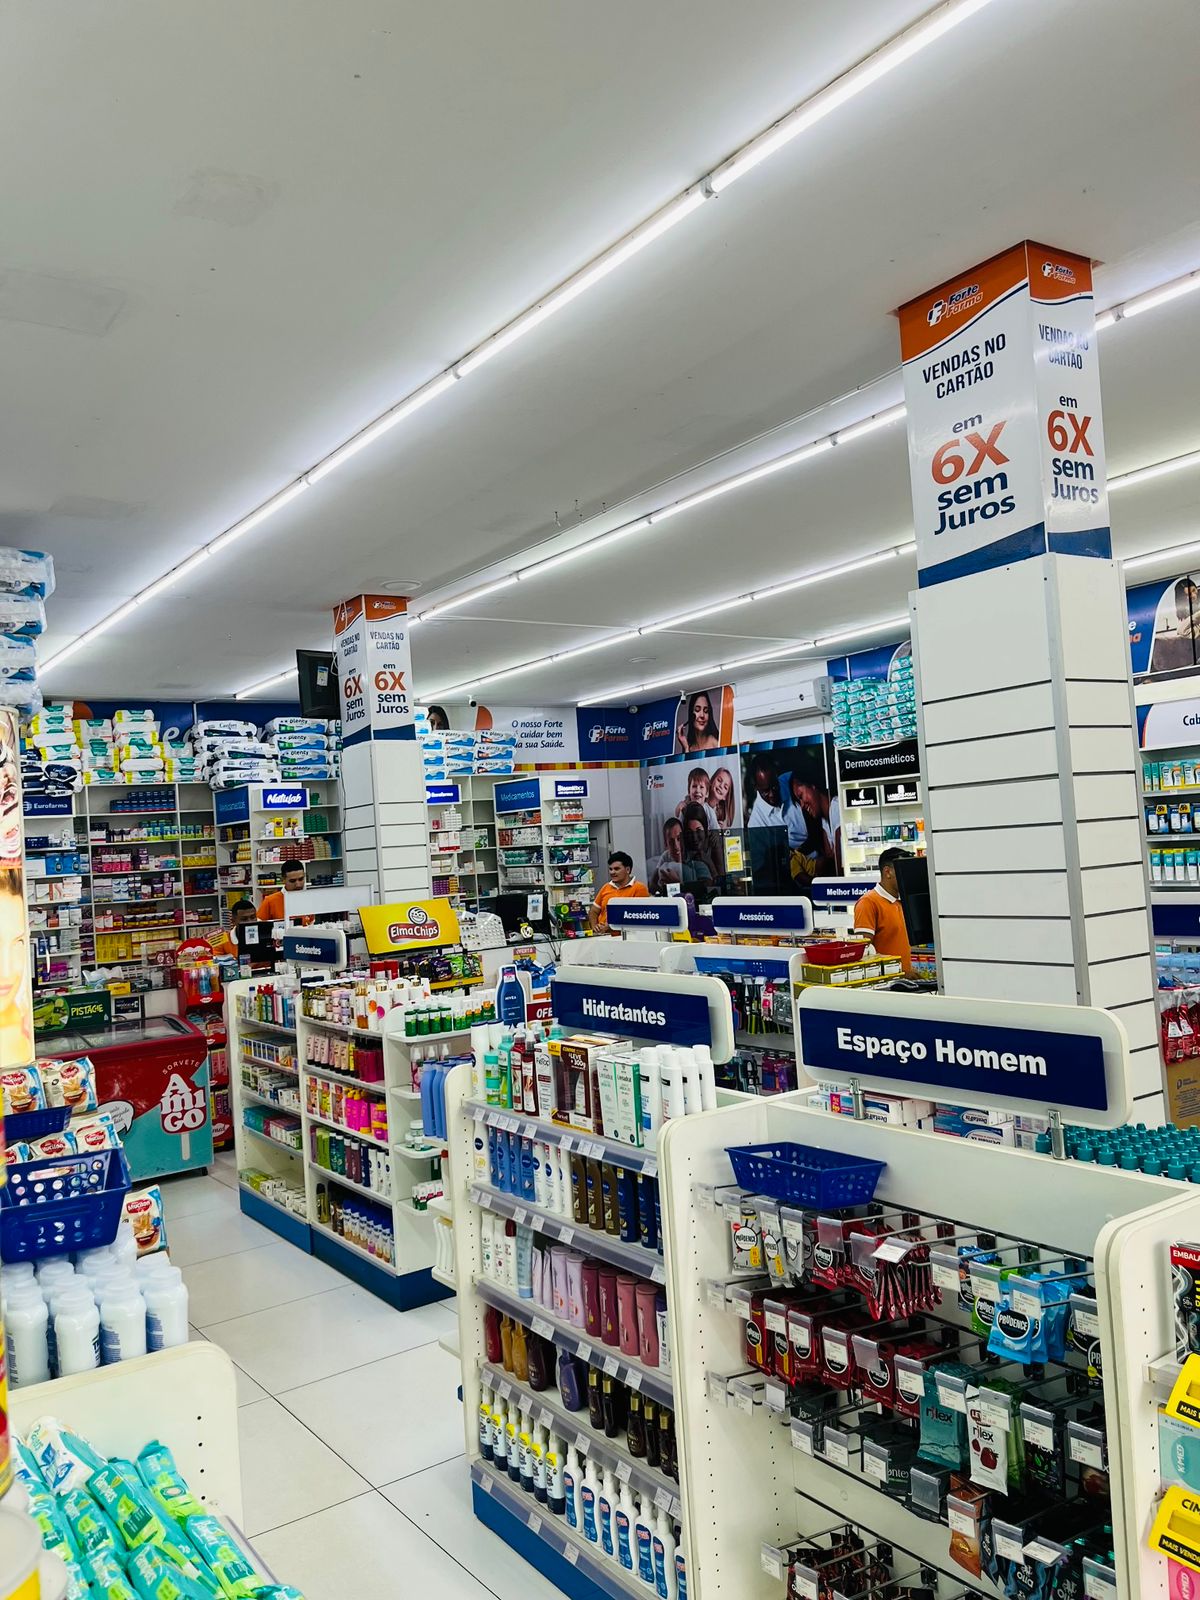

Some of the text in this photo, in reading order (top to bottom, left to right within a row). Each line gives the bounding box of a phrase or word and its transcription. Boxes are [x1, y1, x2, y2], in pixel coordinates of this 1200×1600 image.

[948, 284, 979, 304] Forte
[946, 292, 984, 318] Farma
[922, 333, 1006, 384] VENDAS NO
[1049, 350, 1083, 370] CARTÃO
[936, 361, 994, 399] CARTÃO
[1059, 394, 1078, 408] em
[952, 414, 983, 434] em
[1047, 410, 1094, 456] 6X
[931, 420, 1010, 485] 6X
[1052, 457, 1094, 480] sem
[938, 471, 1008, 511] sem
[1051, 477, 1099, 504] Juros
[934, 495, 1016, 535] Juros
[370, 631, 394, 640] VENDAS
[376, 640, 400, 650] CARTÃO
[344, 673, 363, 699] 6X
[374, 671, 407, 691] 6X
[346, 697, 363, 711] sem
[378, 693, 406, 703] sem
[346, 709, 365, 722] Juros
[376, 703, 409, 714] Juros
[512, 720, 519, 728] O
[544, 720, 563, 728] Forte
[605, 726, 626, 734] Forte
[652, 720, 668, 730] Forte
[520, 730, 563, 738] cuidar bem
[845, 754, 915, 769] Dermocosméticos
[501, 791, 535, 802] Medicamentos
[34, 802, 68, 810] Eurofarma
[827, 888, 850, 896] Melhor
[623, 910, 660, 920] Acessórios
[739, 911, 774, 922] Acessórios
[295, 944, 322, 956] Sabonetes
[71, 1004, 104, 1016] PISTACHE
[582, 998, 666, 1027] Hidratantes
[836, 1027, 1047, 1076] Espaço Homem
[162, 1059, 201, 1075] SORVETE
[127, 1200, 151, 1211] Mucilon
[1180, 1405, 1197, 1417] MAIS
[1162, 1539, 1179, 1552] MAIS
